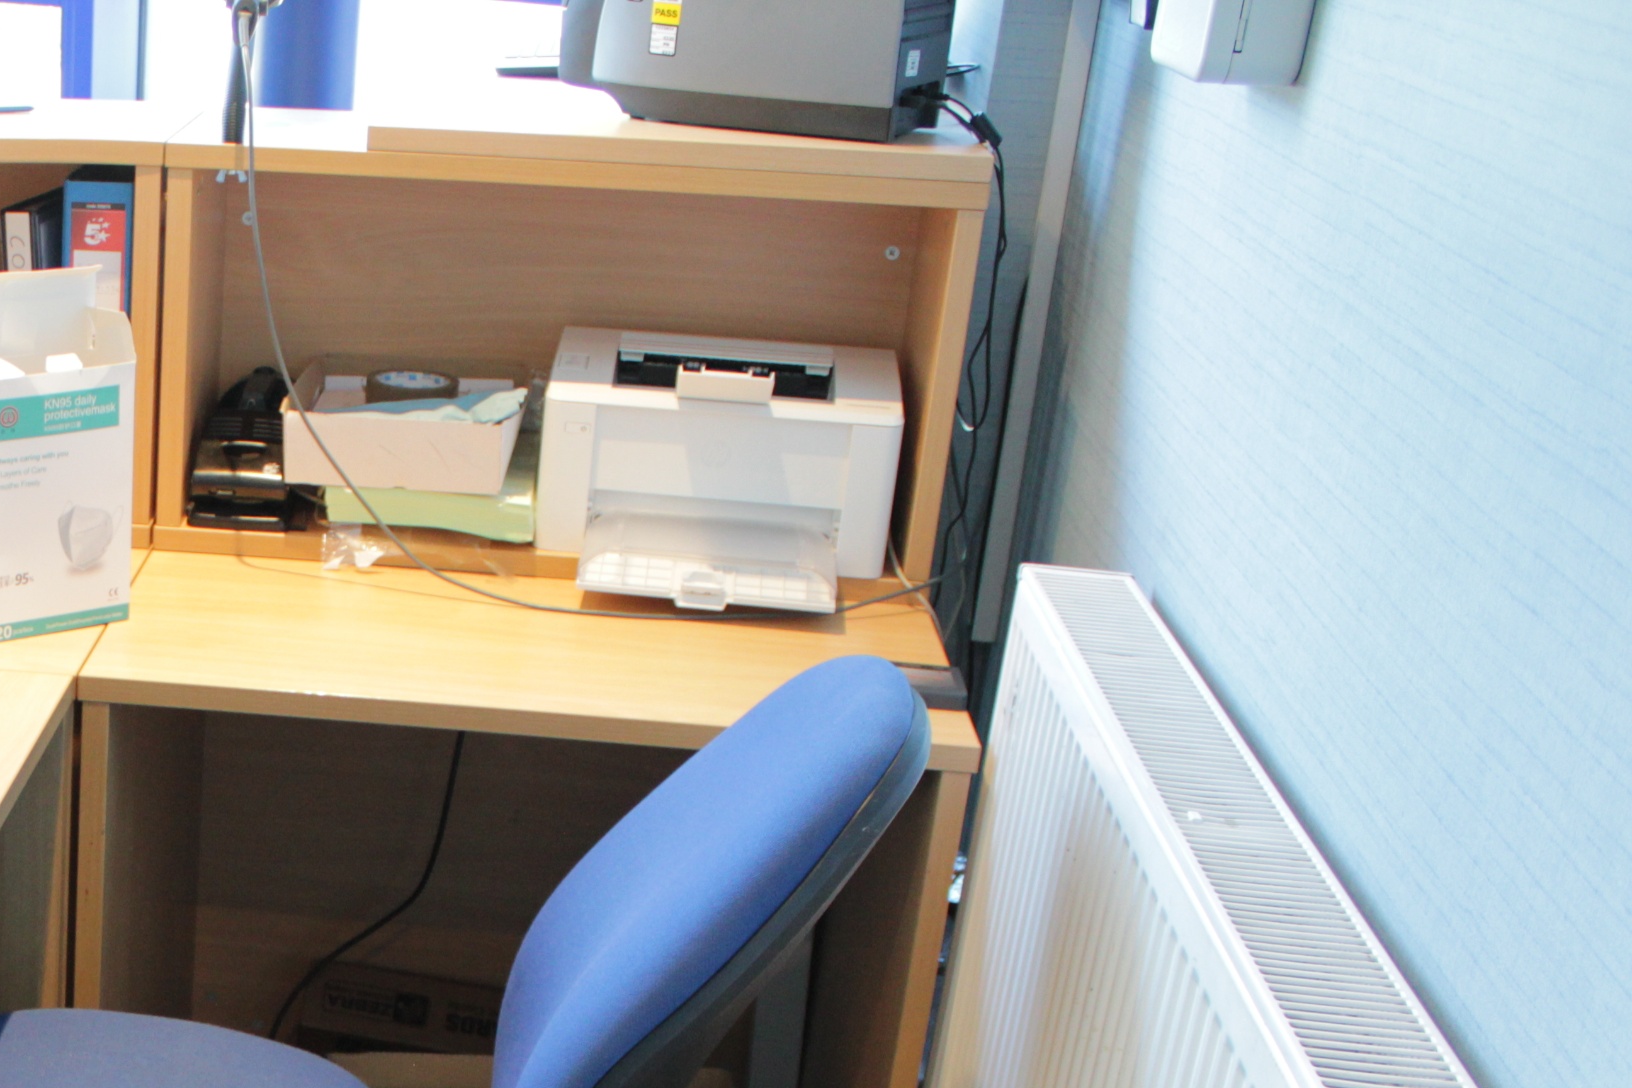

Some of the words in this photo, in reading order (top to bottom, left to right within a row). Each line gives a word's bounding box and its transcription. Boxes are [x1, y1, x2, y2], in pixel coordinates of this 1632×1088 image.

[654, 8, 678, 18] PASS
[44, 397, 72, 410] KN95
[74, 394, 97, 406] daily
[44, 402, 116, 423] protectivemask
